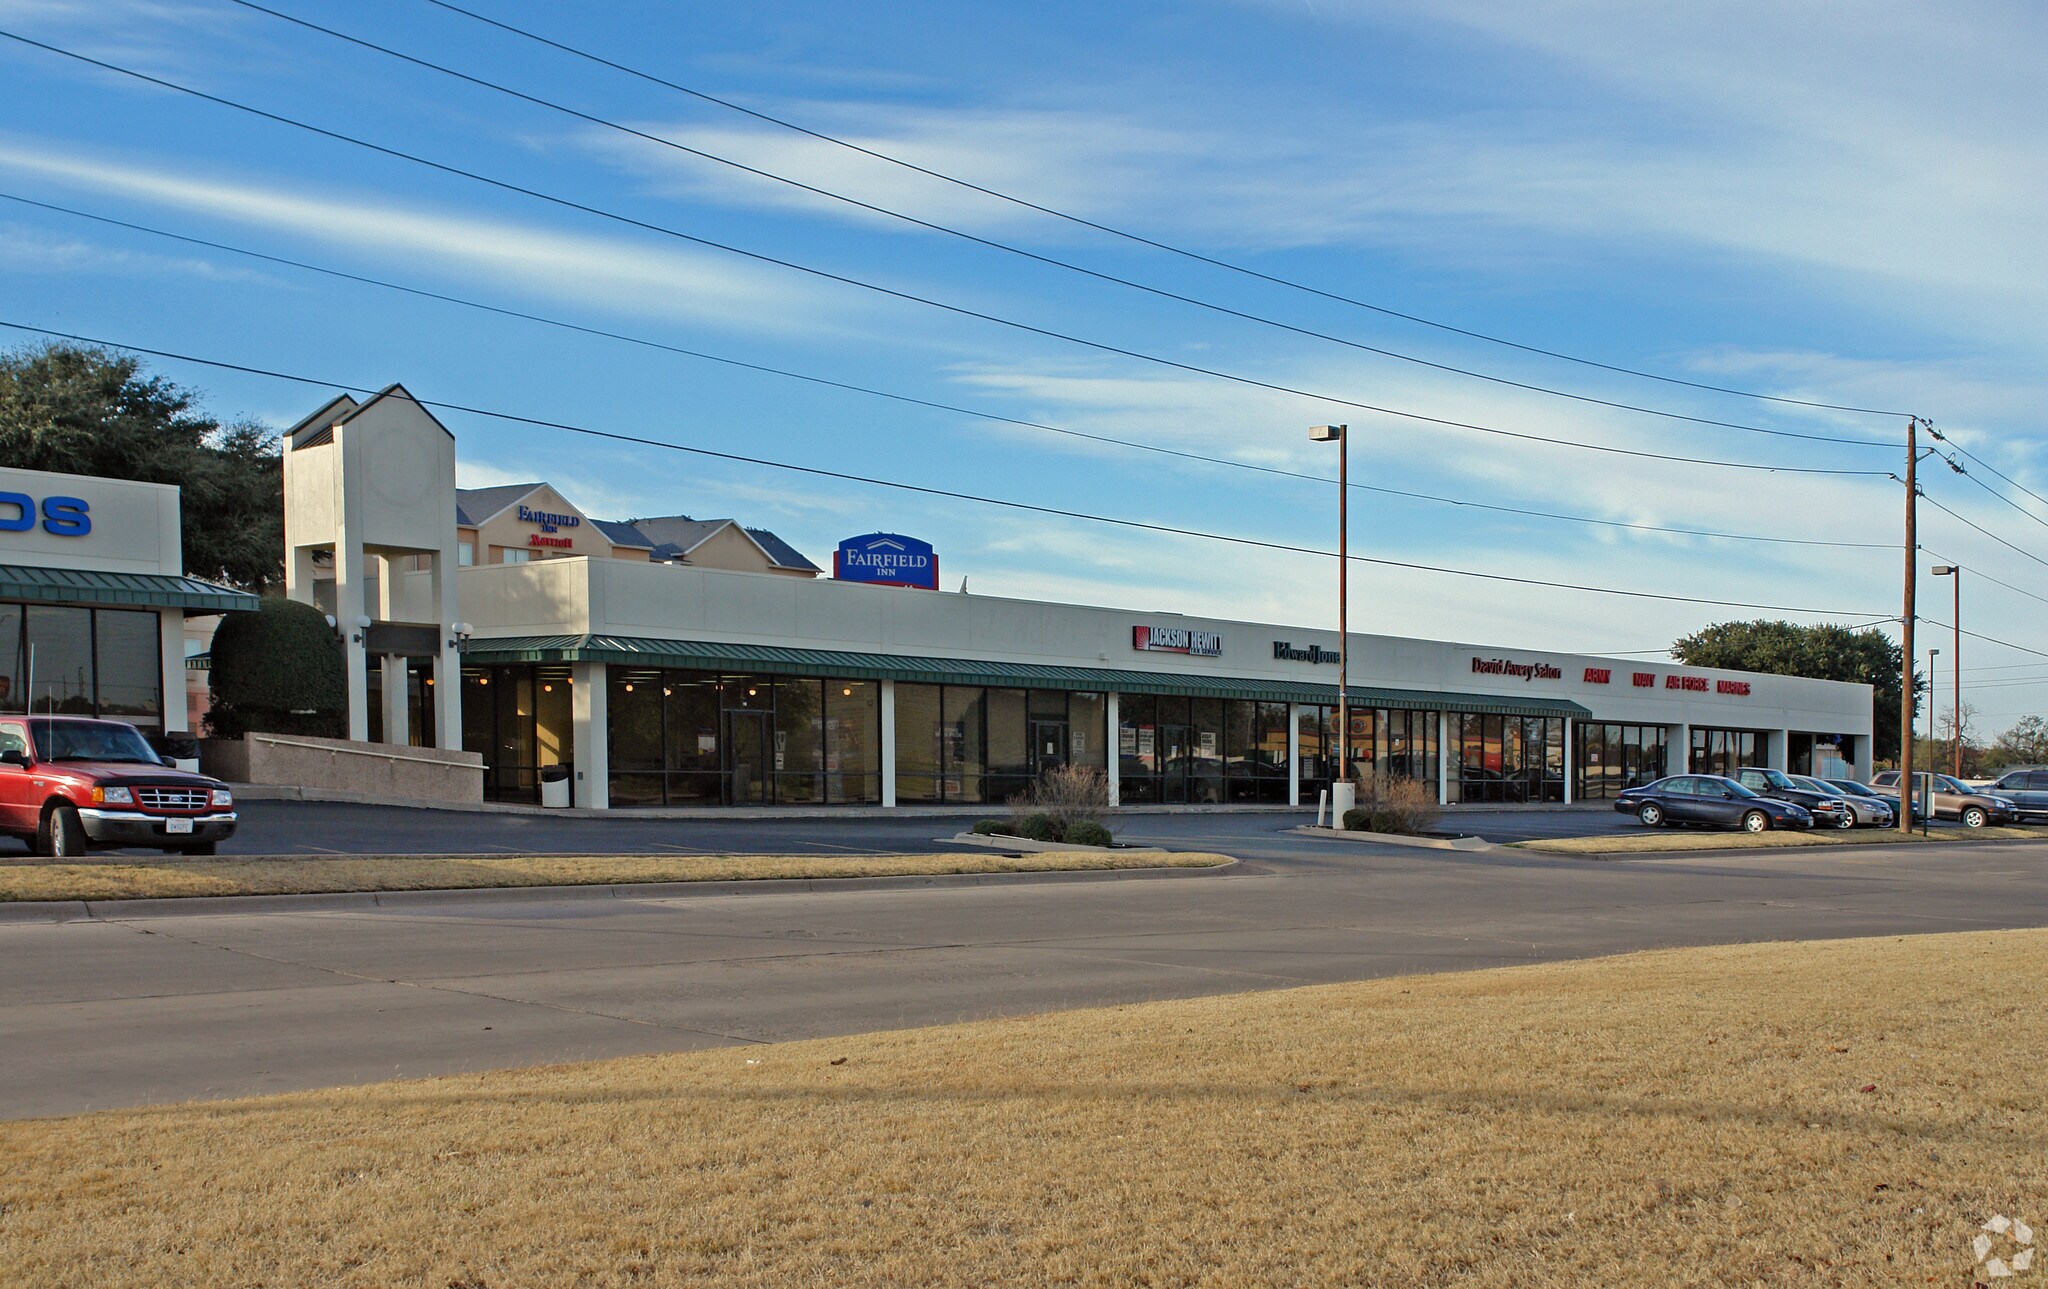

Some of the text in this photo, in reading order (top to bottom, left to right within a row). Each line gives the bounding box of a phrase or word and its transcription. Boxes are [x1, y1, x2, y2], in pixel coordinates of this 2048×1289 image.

[518, 505, 580, 527] FAIRFIELD
[846, 549, 927, 568] FAIRFIELD
[877, 568, 896, 577] INN
[1149, 627, 1223, 650] JACKSON HEWITT
[1472, 657, 1562, 681] David Avery Salon
[1583, 667, 1751, 696] ARMY NAVY AIR FORCE MARINES
